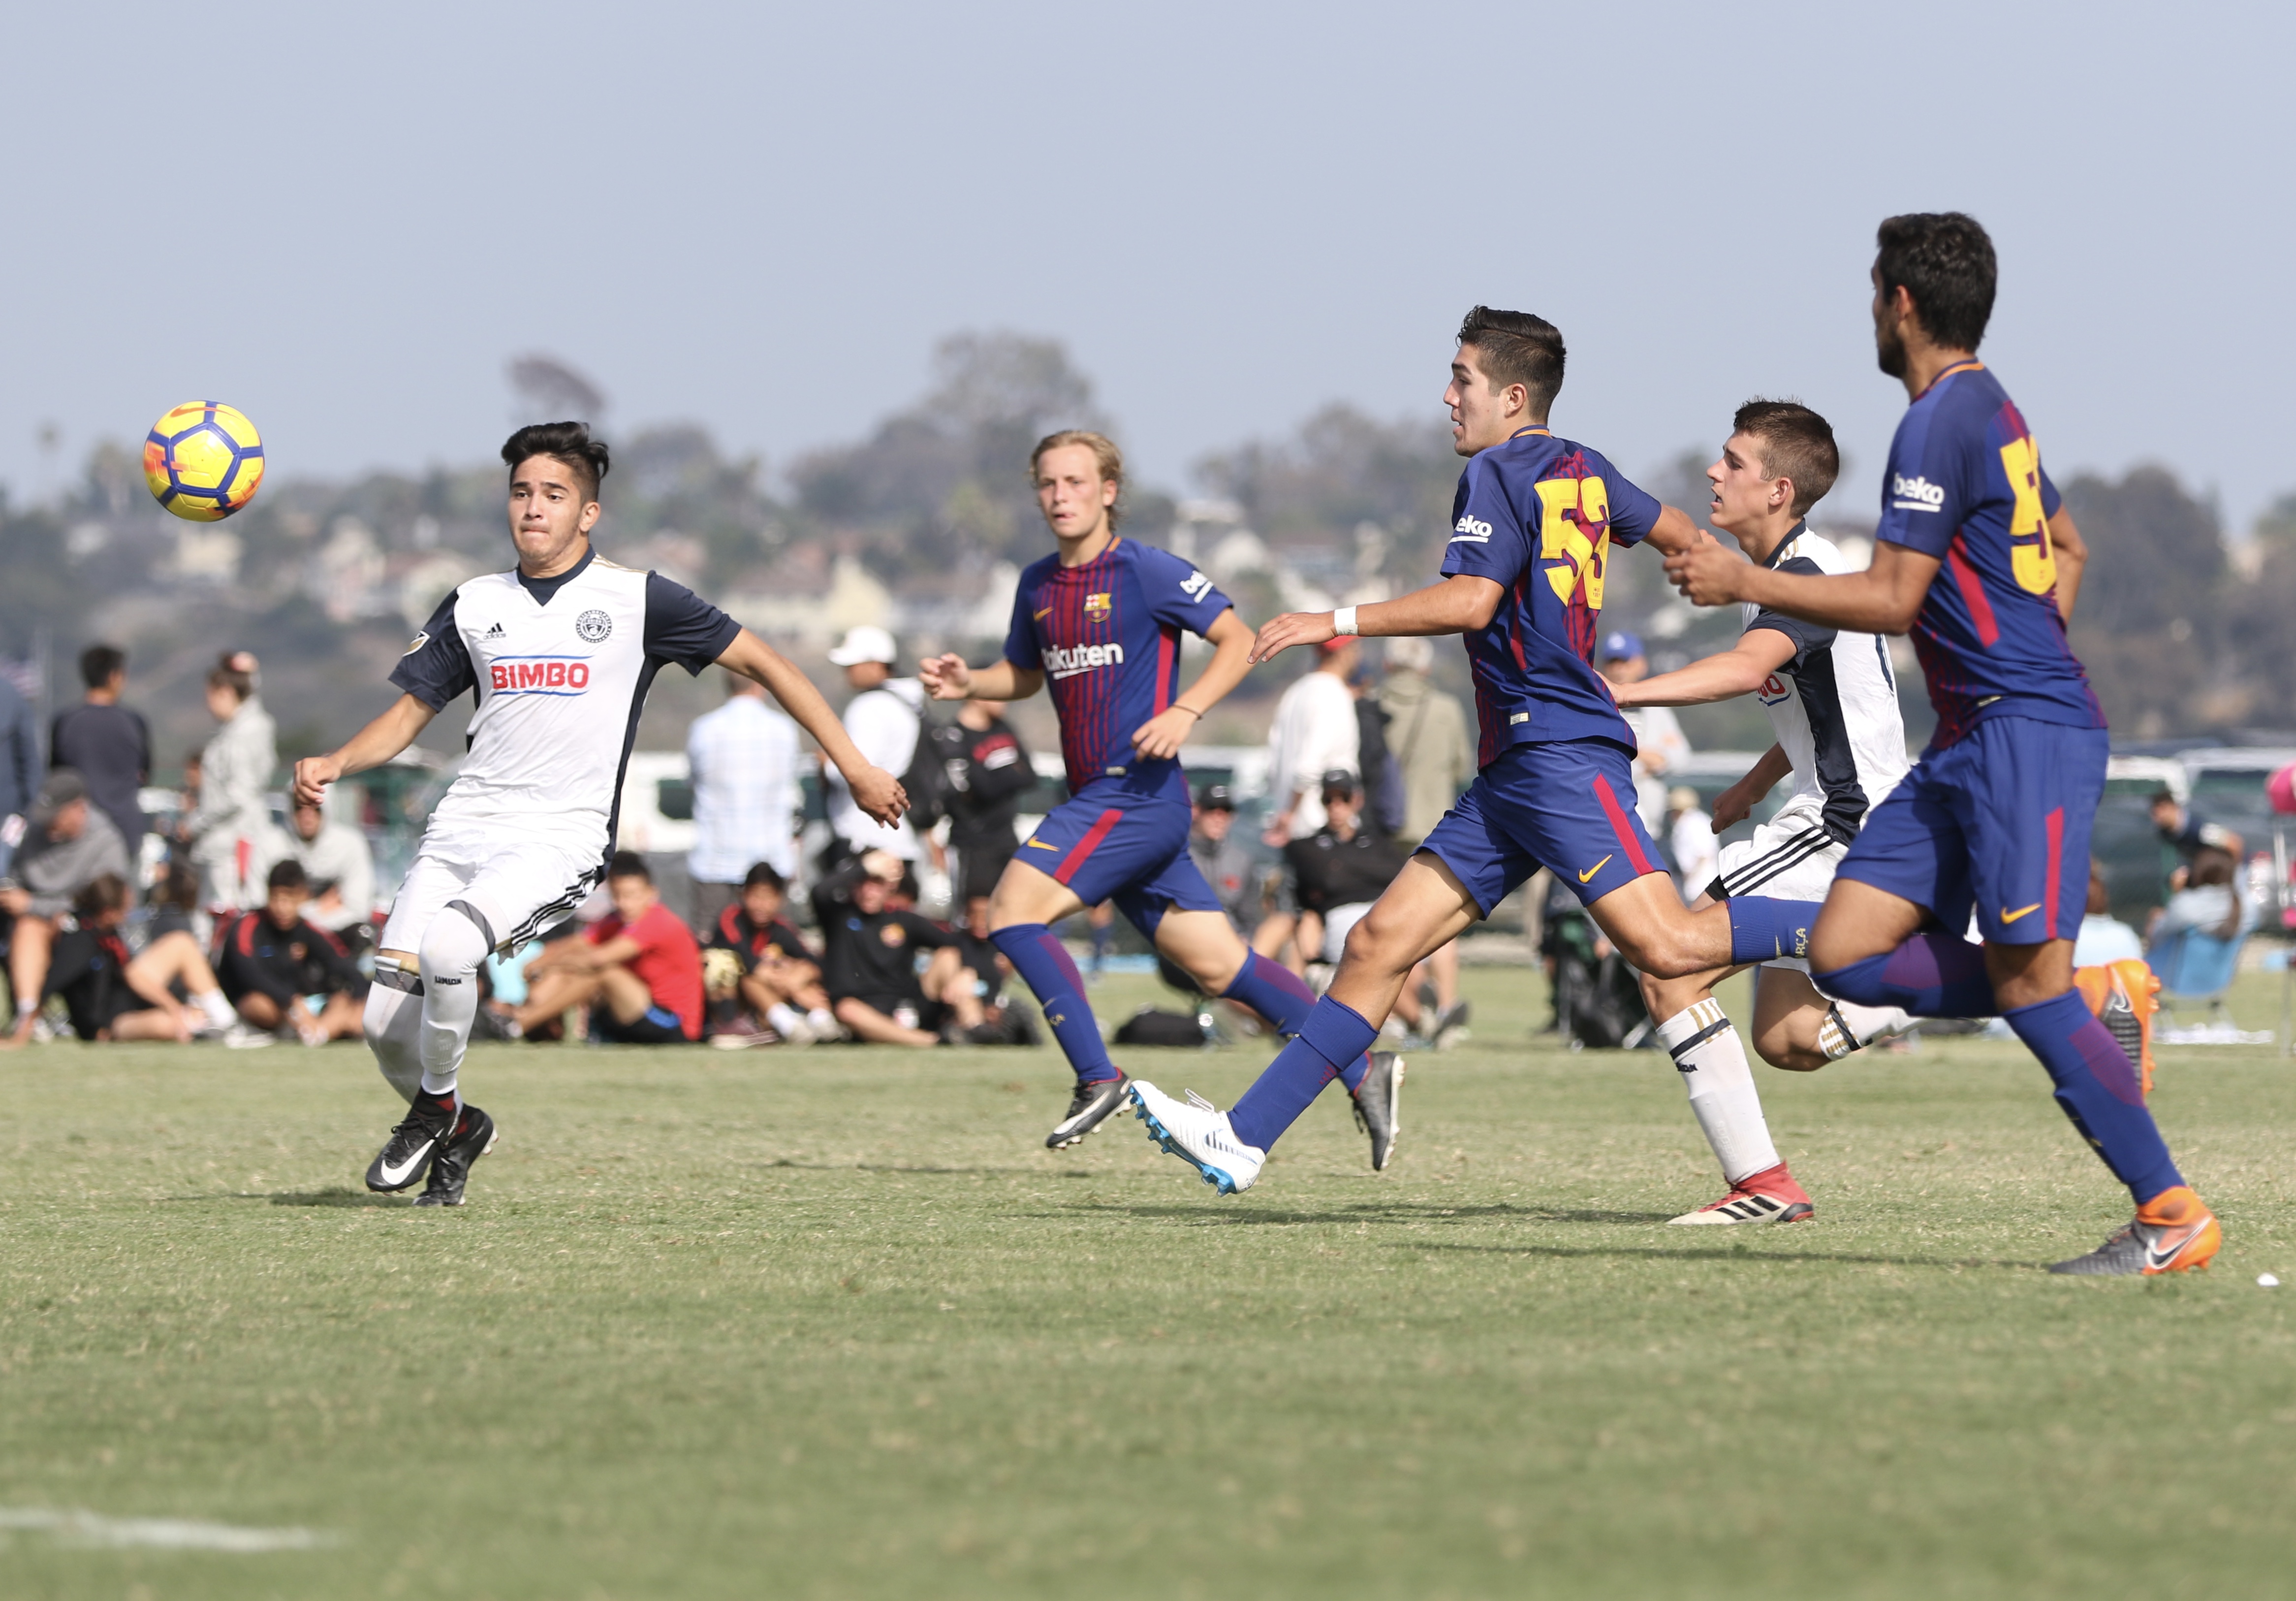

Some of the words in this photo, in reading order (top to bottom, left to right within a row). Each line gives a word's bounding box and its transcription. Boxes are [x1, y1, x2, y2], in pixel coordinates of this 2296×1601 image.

[1893, 472, 1944, 505] beko
[1455, 514, 1493, 537] eko
[491, 663, 589, 689] BIMBO
